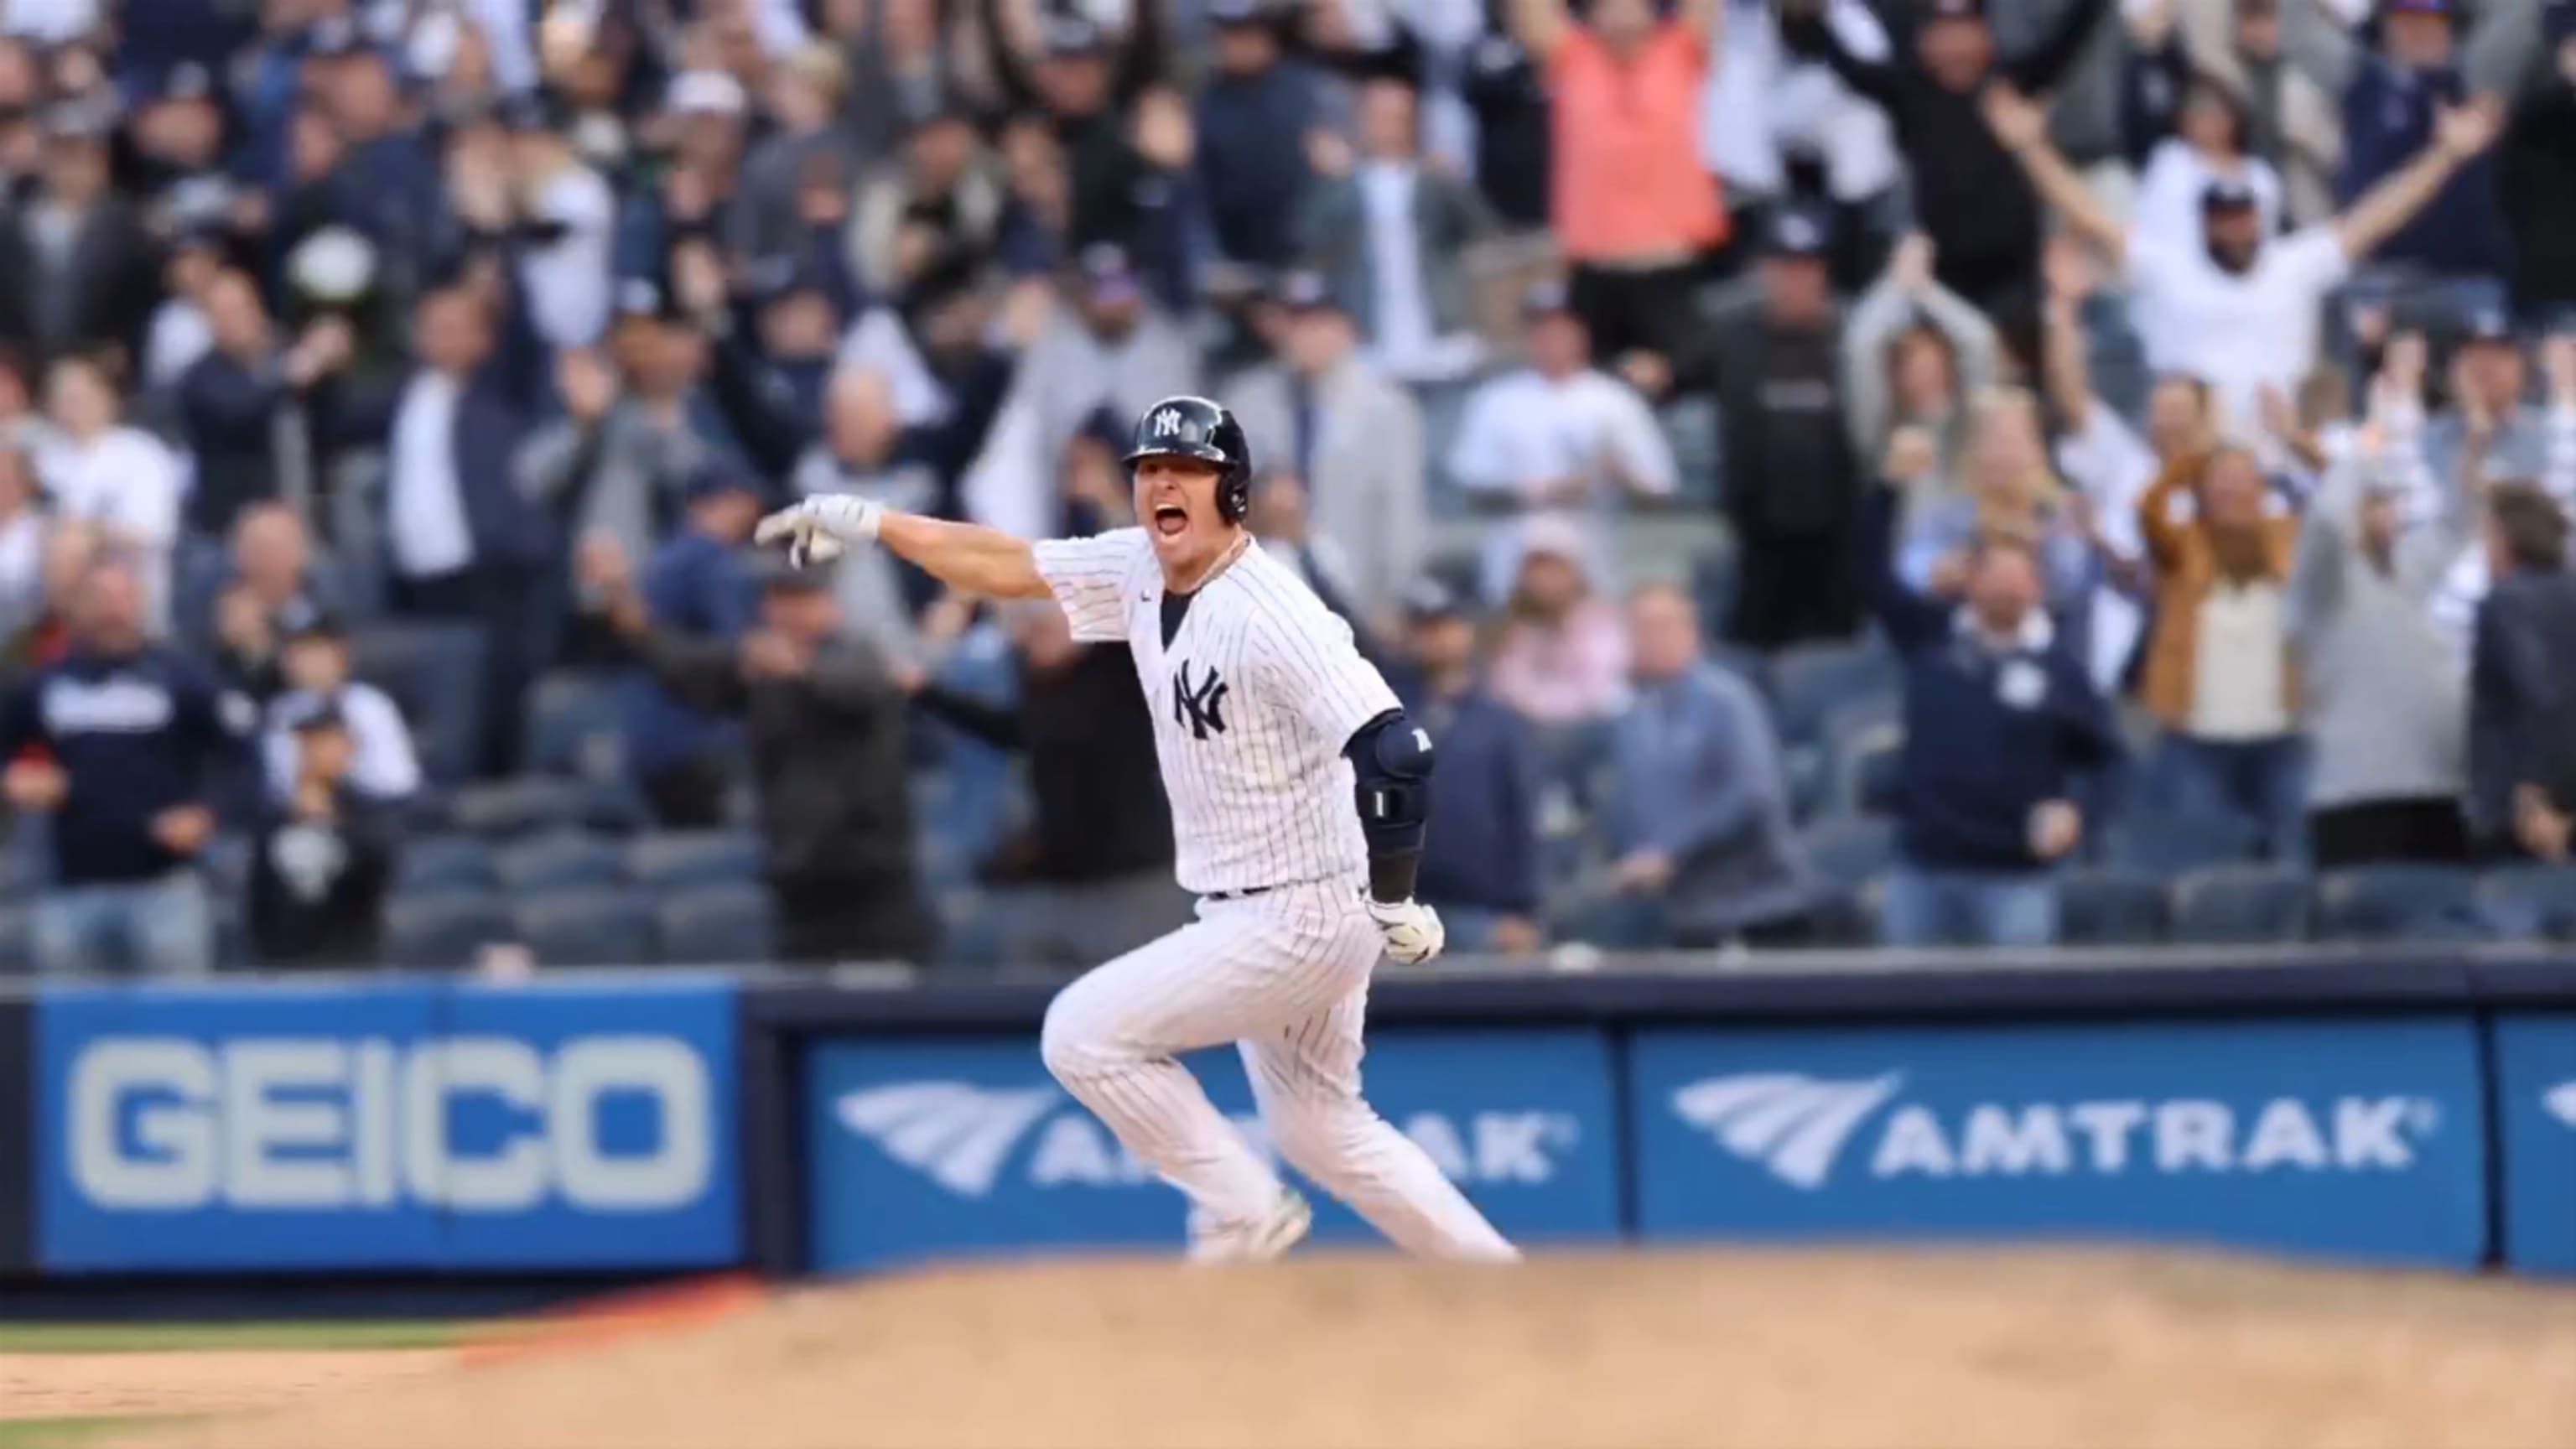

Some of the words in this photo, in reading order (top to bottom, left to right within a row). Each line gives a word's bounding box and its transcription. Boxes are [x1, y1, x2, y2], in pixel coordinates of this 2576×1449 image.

[1154, 408, 1182, 437] NY
[1173, 658, 1229, 740] NY
[67, 1035, 713, 1212] GEICO
